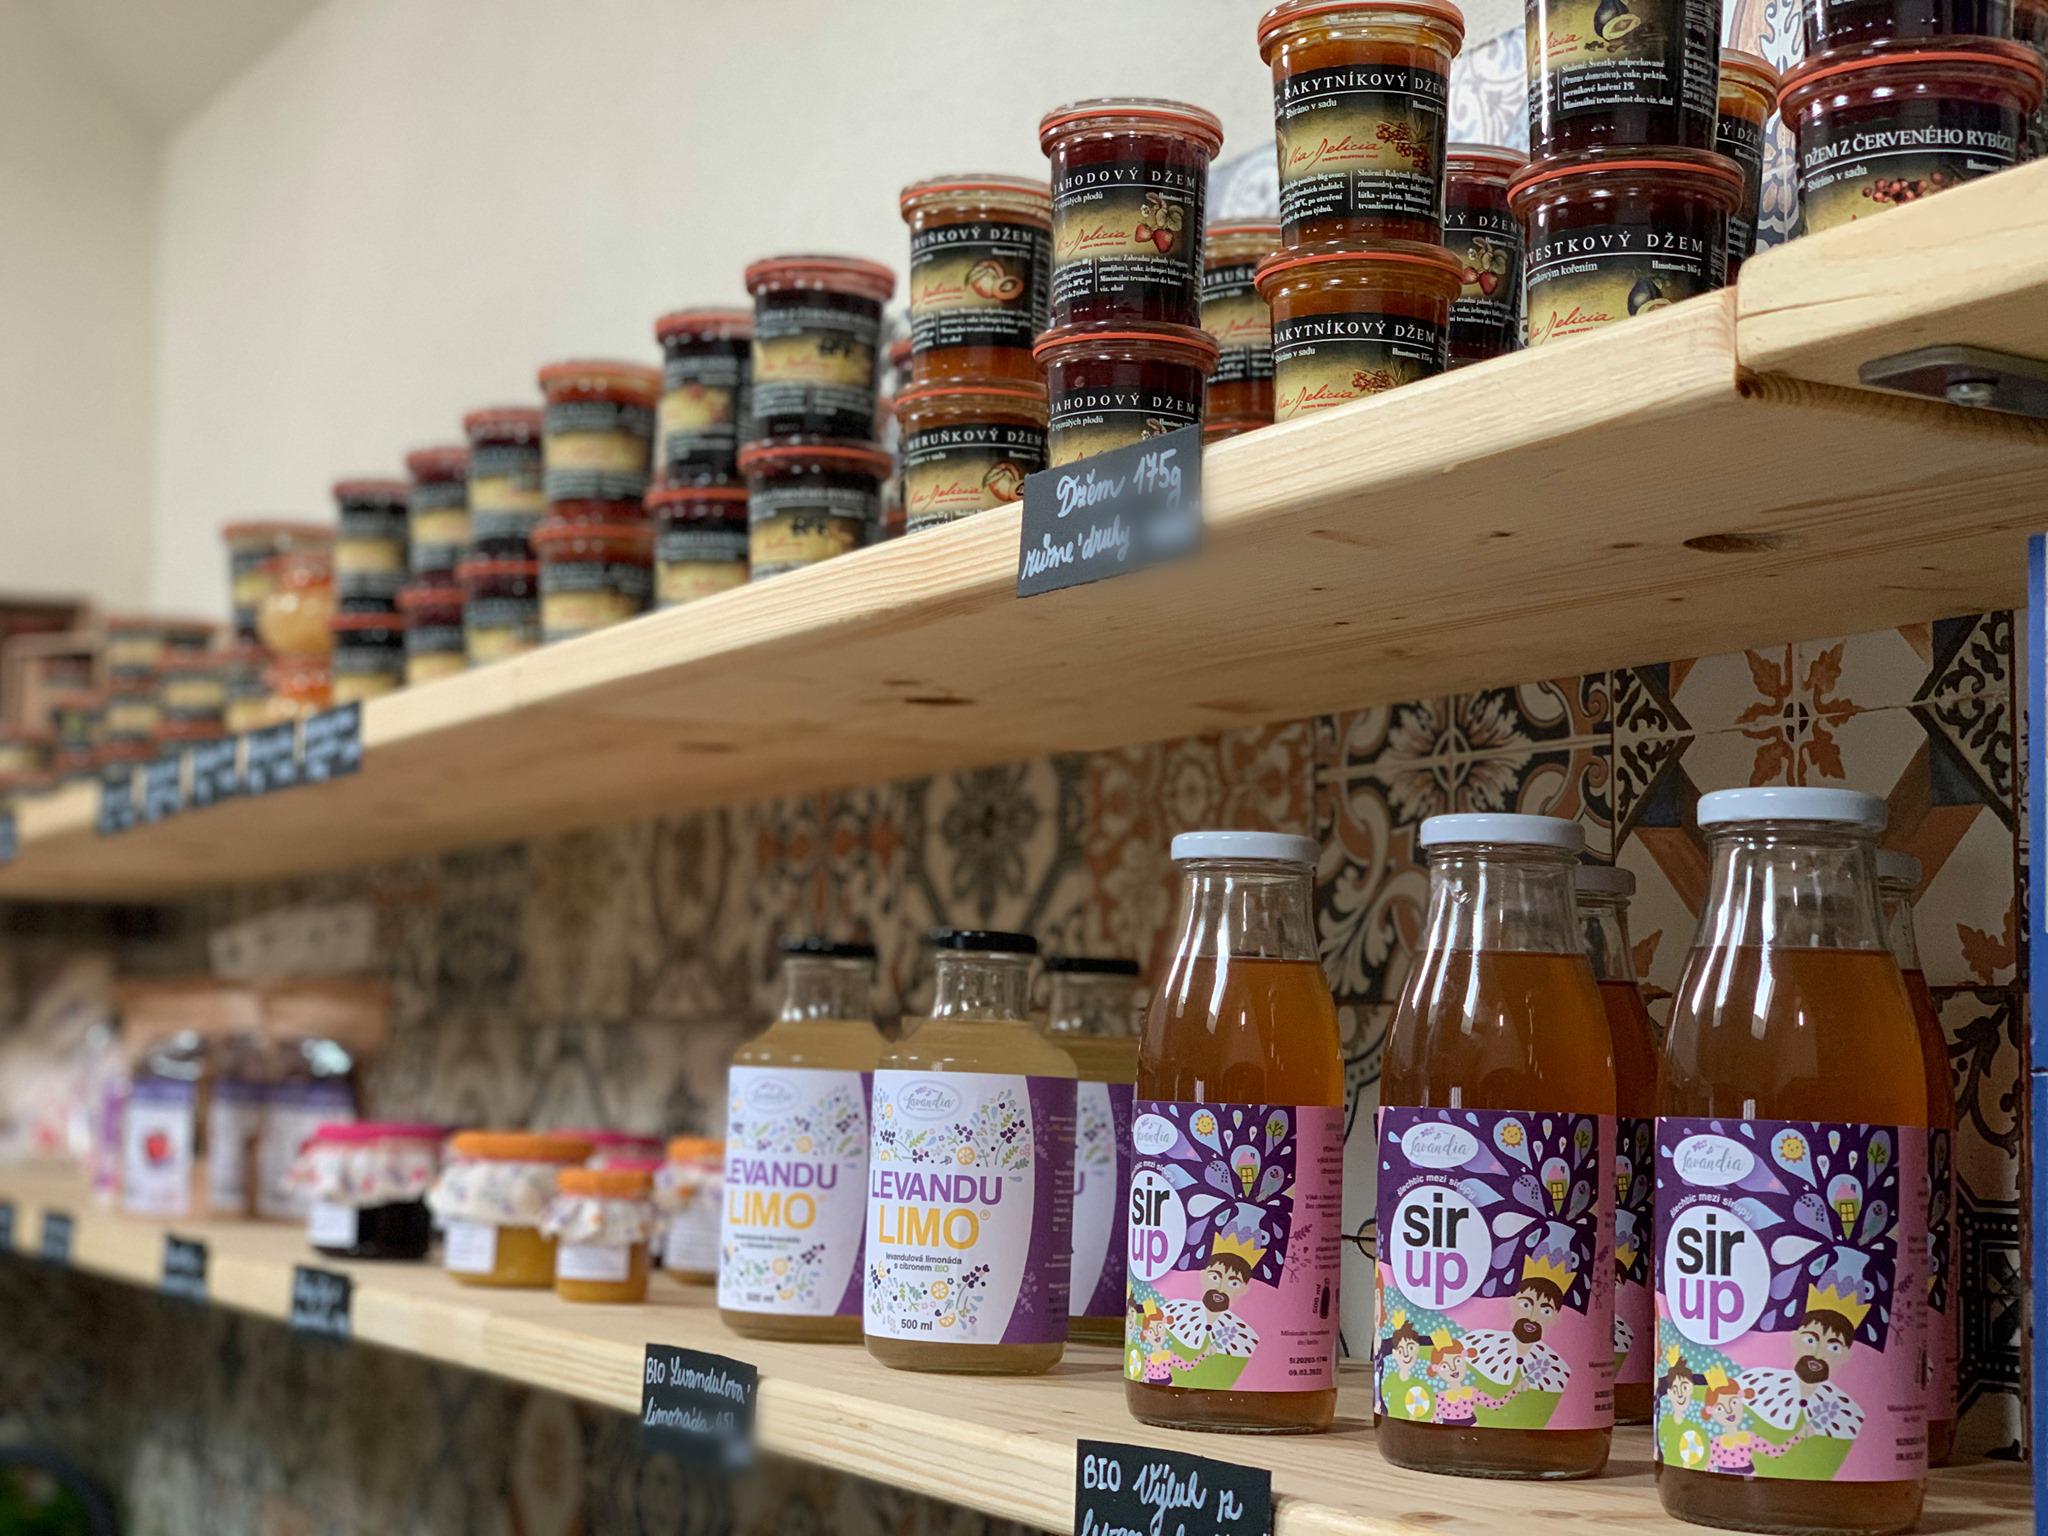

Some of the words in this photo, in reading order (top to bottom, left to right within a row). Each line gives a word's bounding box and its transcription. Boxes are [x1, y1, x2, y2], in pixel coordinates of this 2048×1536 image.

[1284, 71, 1408, 100] RAKYTNÍKOVÝ
[1804, 142, 1838, 169] DŽEM
[1839, 139, 1850, 155] Z
[1852, 125, 1964, 152] ČERVENÉHO
[1151, 169, 1195, 189] DŽEM
[989, 227, 1033, 243] DŽEM
[1647, 232, 1703, 253] DŽEM
[1274, 319, 1387, 346] RAKYTNÍKOVÝ
[1394, 324, 1435, 344] DŽEM
[1051, 392, 1140, 415] JAHODOVÝ
[1152, 396, 1195, 414] DŽEM
[1133, 448, 1182, 511] 175g
[871, 1169, 1003, 1206] LEVANDU
[1131, 1176, 1170, 1227] sir
[1425, 1174, 1448, 1184] mezi
[1448, 1177, 1478, 1200] sirupy
[728, 1189, 816, 1230] LIMO
[1402, 1192, 1470, 1249] sir
[1698, 1193, 1721, 1203] mezi
[1721, 1197, 1753, 1222] sirupy
[885, 1251, 924, 1263] levandulová
[925, 1253, 963, 1265] limonáda
[1131, 1227, 1170, 1277] up
[1675, 1213, 1745, 1278] sir
[899, 1262, 933, 1272] citronem
[934, 1265, 950, 1273] BIO
[1405, 1249, 1469, 1306] up
[1678, 1278, 1745, 1341] up
[900, 1318, 918, 1330] 500
[920, 1320, 933, 1331] ml
[645, 1356, 666, 1385] BIO
[1083, 1453, 1122, 1493] BIO
